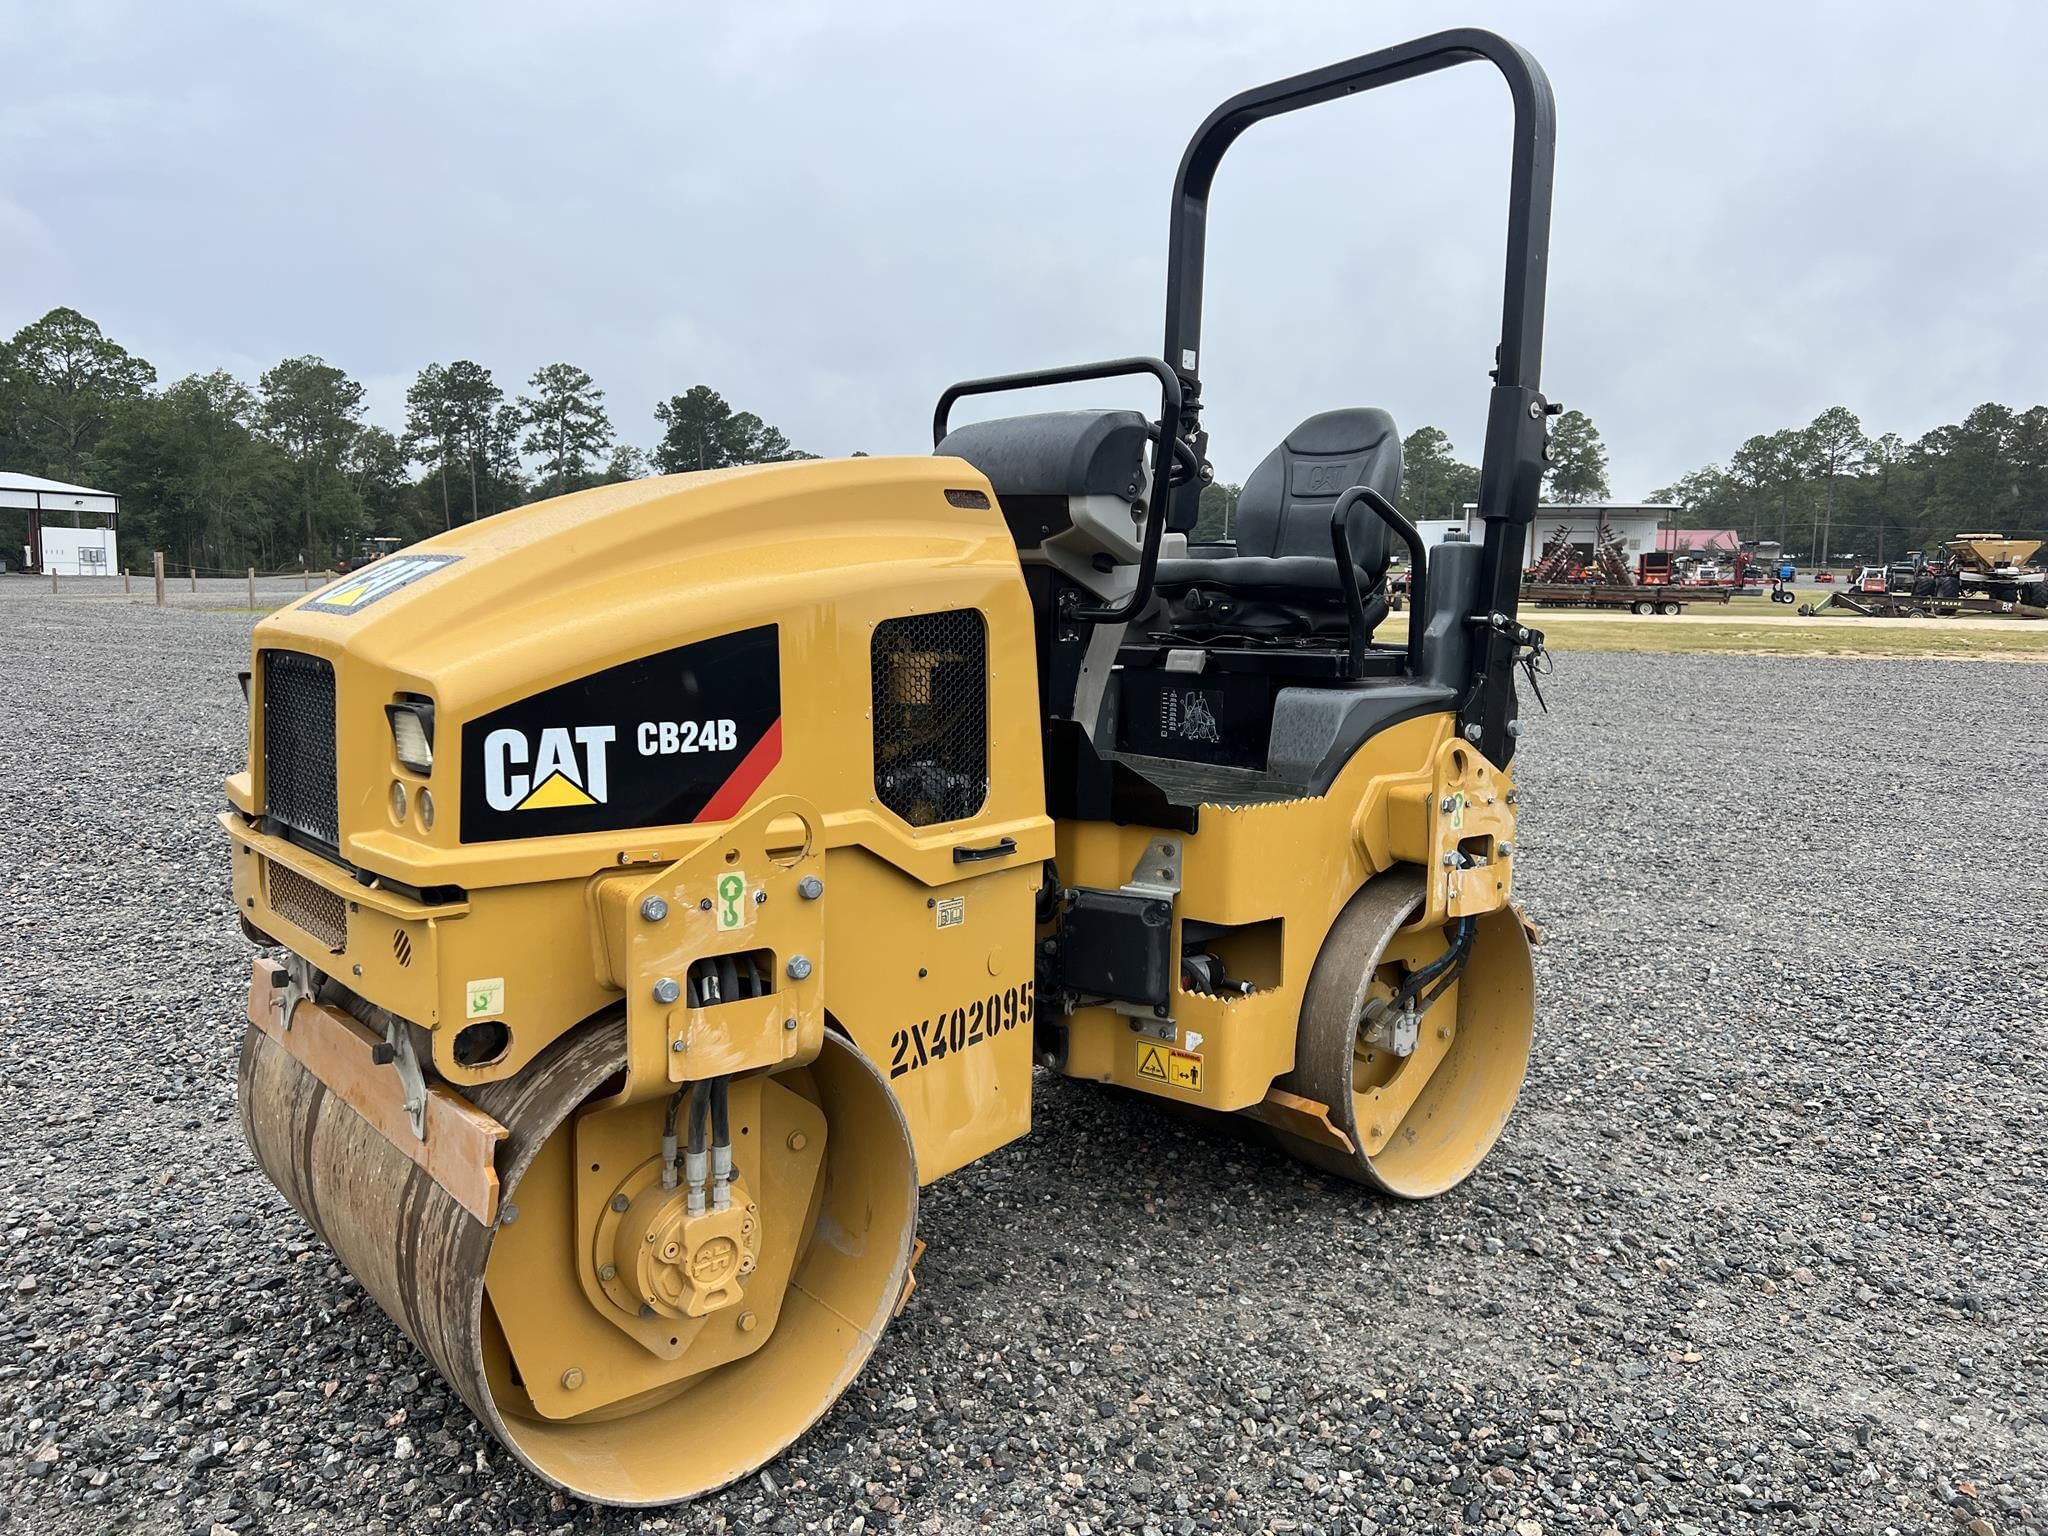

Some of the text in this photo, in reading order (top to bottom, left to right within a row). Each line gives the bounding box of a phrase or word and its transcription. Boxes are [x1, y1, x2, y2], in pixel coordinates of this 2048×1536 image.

[1310, 465, 1347, 491] CAT
[314, 559, 447, 607] CAT
[484, 719, 738, 811] CAT CB24B
[890, 980, 1034, 1080] 2X402095
